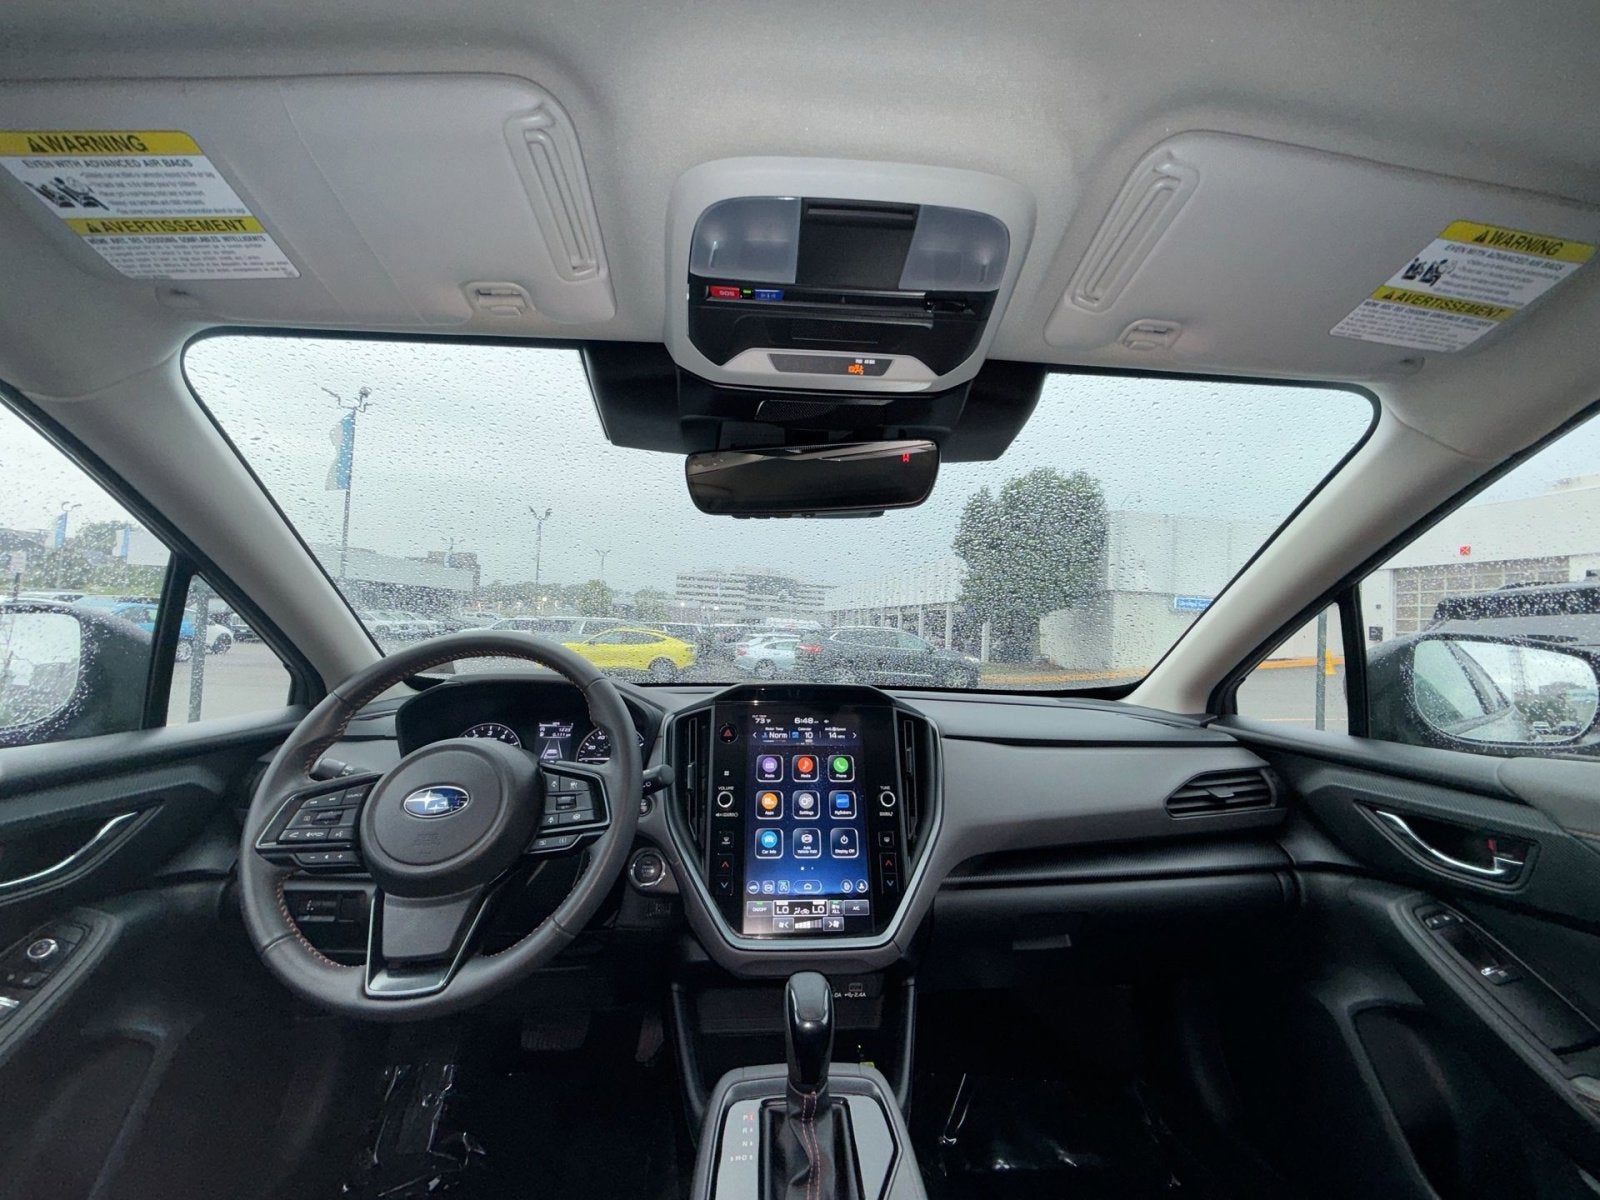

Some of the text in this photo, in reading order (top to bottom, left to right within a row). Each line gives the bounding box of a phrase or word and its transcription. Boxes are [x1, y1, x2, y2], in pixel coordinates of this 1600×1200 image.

[42, 134, 148, 153] WARNING
[22, 158, 194, 168] EVEN WITH ADVANCED AIR BAGS
[101, 218, 248, 233] AVERTISSEMENT
[1488, 229, 1565, 256] WARNING
[1397, 291, 1506, 319] AVERTISSEMENT
[776, 906, 789, 914] LO
[812, 906, 825, 914] LO
